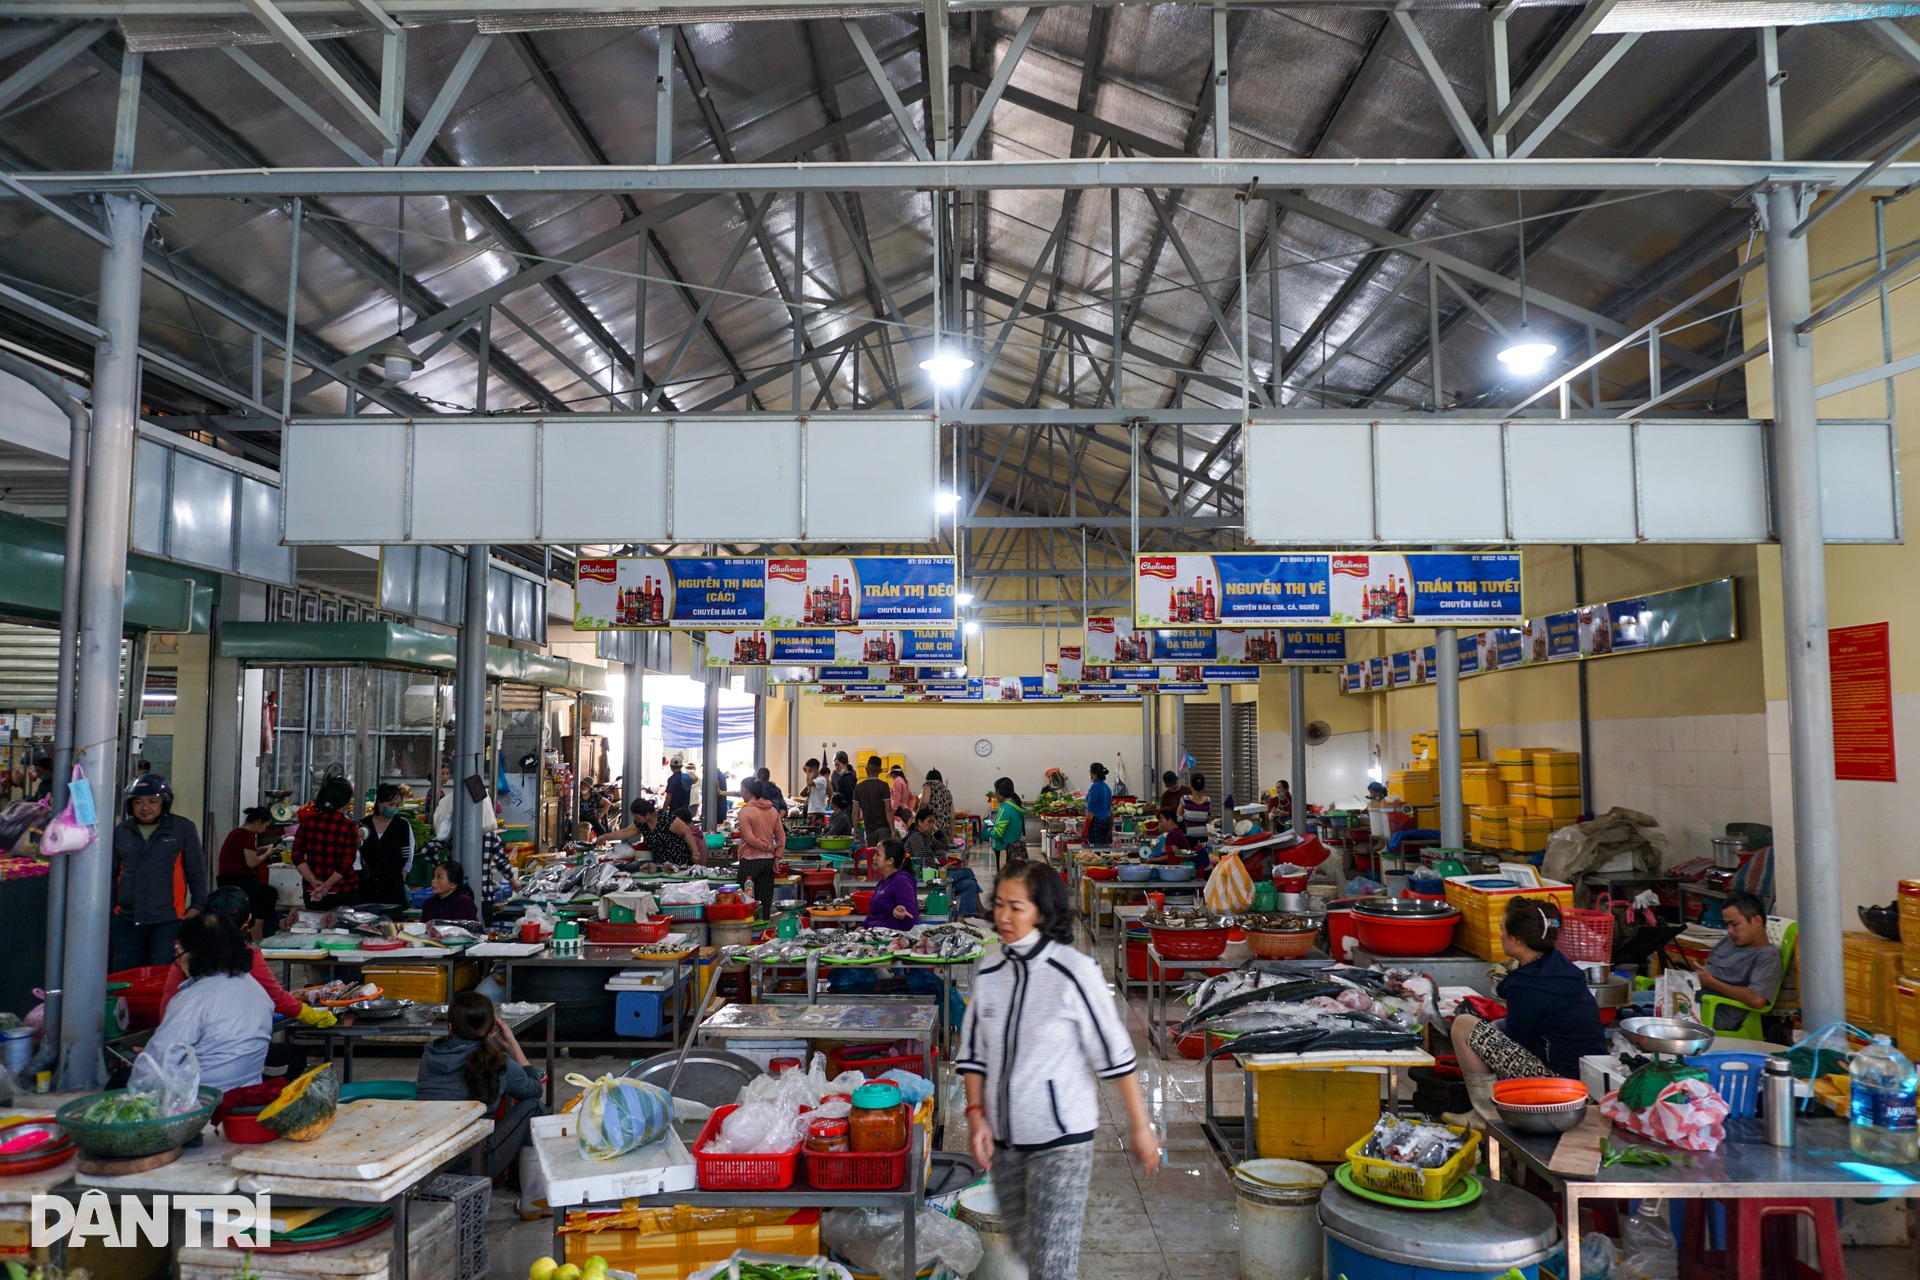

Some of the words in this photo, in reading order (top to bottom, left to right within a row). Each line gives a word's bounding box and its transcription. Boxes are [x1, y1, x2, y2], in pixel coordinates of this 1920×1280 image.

[580, 564, 616, 574] Cholimex
[769, 563, 805, 573] Cholimex
[1140, 562, 1176, 571] Cholimex
[1333, 560, 1368, 569] Cholimex
[678, 576, 720, 588] NGUYỄN
[723, 579, 739, 590] THỊ
[742, 579, 764, 589] NGA
[1226, 579, 1282, 595] NGUYỄN
[1284, 583, 1306, 597] THỊ
[1417, 577, 1452, 593] TRẦN
[1455, 581, 1477, 595] THỊ
[1481, 577, 1520, 593] TUYẾT
[864, 582, 900, 597] TRẦN
[903, 585, 924, 599] THỊ
[706, 591, 736, 603] (CÁC)
[1440, 600, 1471, 608] CHUYÊN
[1473, 600, 1489, 608] BÁN
[1491, 600, 1502, 608] CÁ
[692, 608, 720, 616] CHUYÊN
[721, 608, 736, 616] BÁN
[737, 608, 747, 616] CÁ
[877, 606, 901, 614] CHUYÊN
[902, 606, 916, 614] BÁN
[917, 606, 927, 614] HẢI
[929, 606, 942, 614] SẢN
[775, 638, 798, 646] PHẠM
[801, 637, 813, 646] THỊ
[815, 636, 834, 645] NĂM
[1287, 631, 1303, 643] VÕ
[1305, 633, 1324, 645] THỊ
[1326, 631, 1342, 643] BÉ
[915, 642, 934, 650] KIM
[936, 642, 953, 650] CHI
[1181, 638, 1205, 649] THẢO
